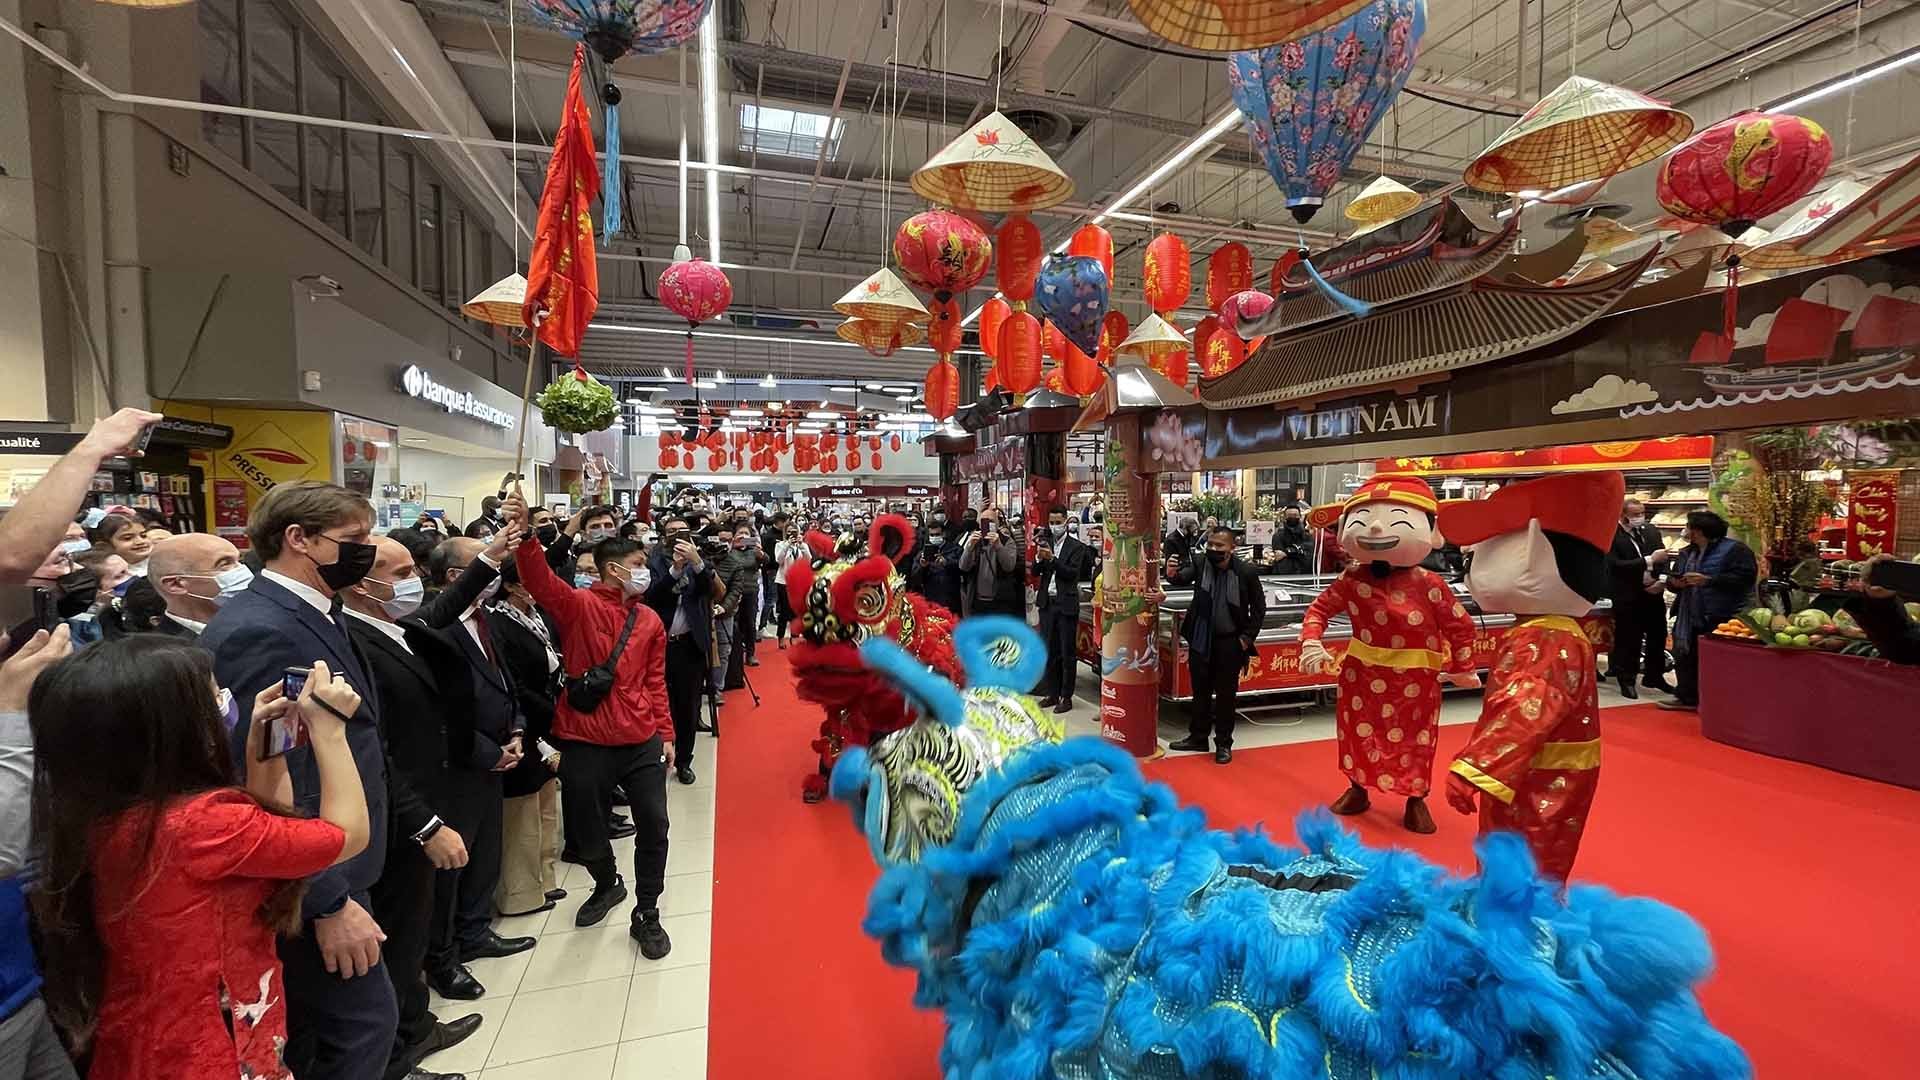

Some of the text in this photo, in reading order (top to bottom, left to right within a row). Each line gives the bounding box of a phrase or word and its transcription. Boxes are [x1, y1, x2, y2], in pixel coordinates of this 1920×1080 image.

[423, 371, 515, 430] banque & assurances
[1288, 395, 1438, 441] VIETNAM
[1171, 480, 1192, 491] celi
